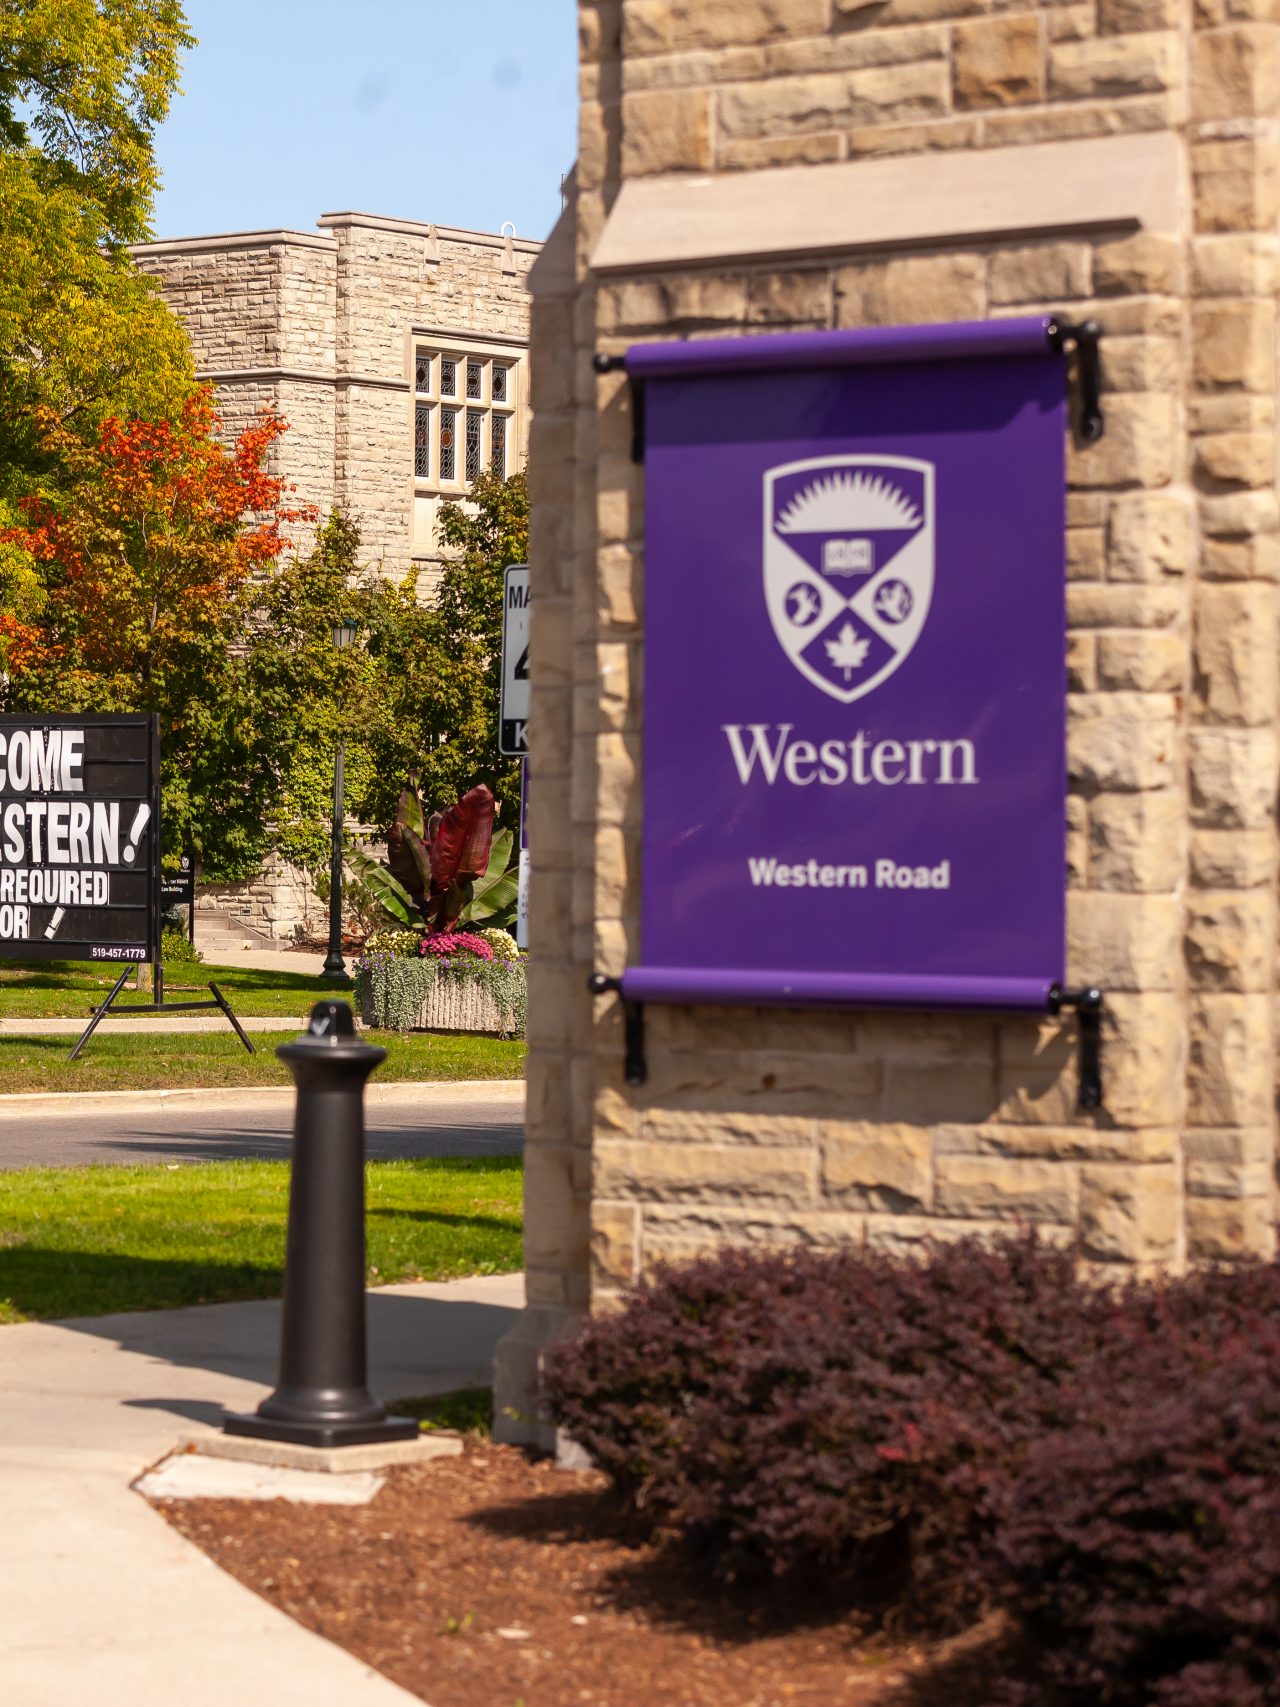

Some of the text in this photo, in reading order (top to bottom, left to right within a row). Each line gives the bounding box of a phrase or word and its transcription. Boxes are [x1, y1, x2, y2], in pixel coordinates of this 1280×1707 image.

[721, 723, 980, 786] Western
[0, 868, 109, 905] REQUIRED
[748, 857, 951, 889] Western Road
[92, 947, 146, 959] 519-457-1779
